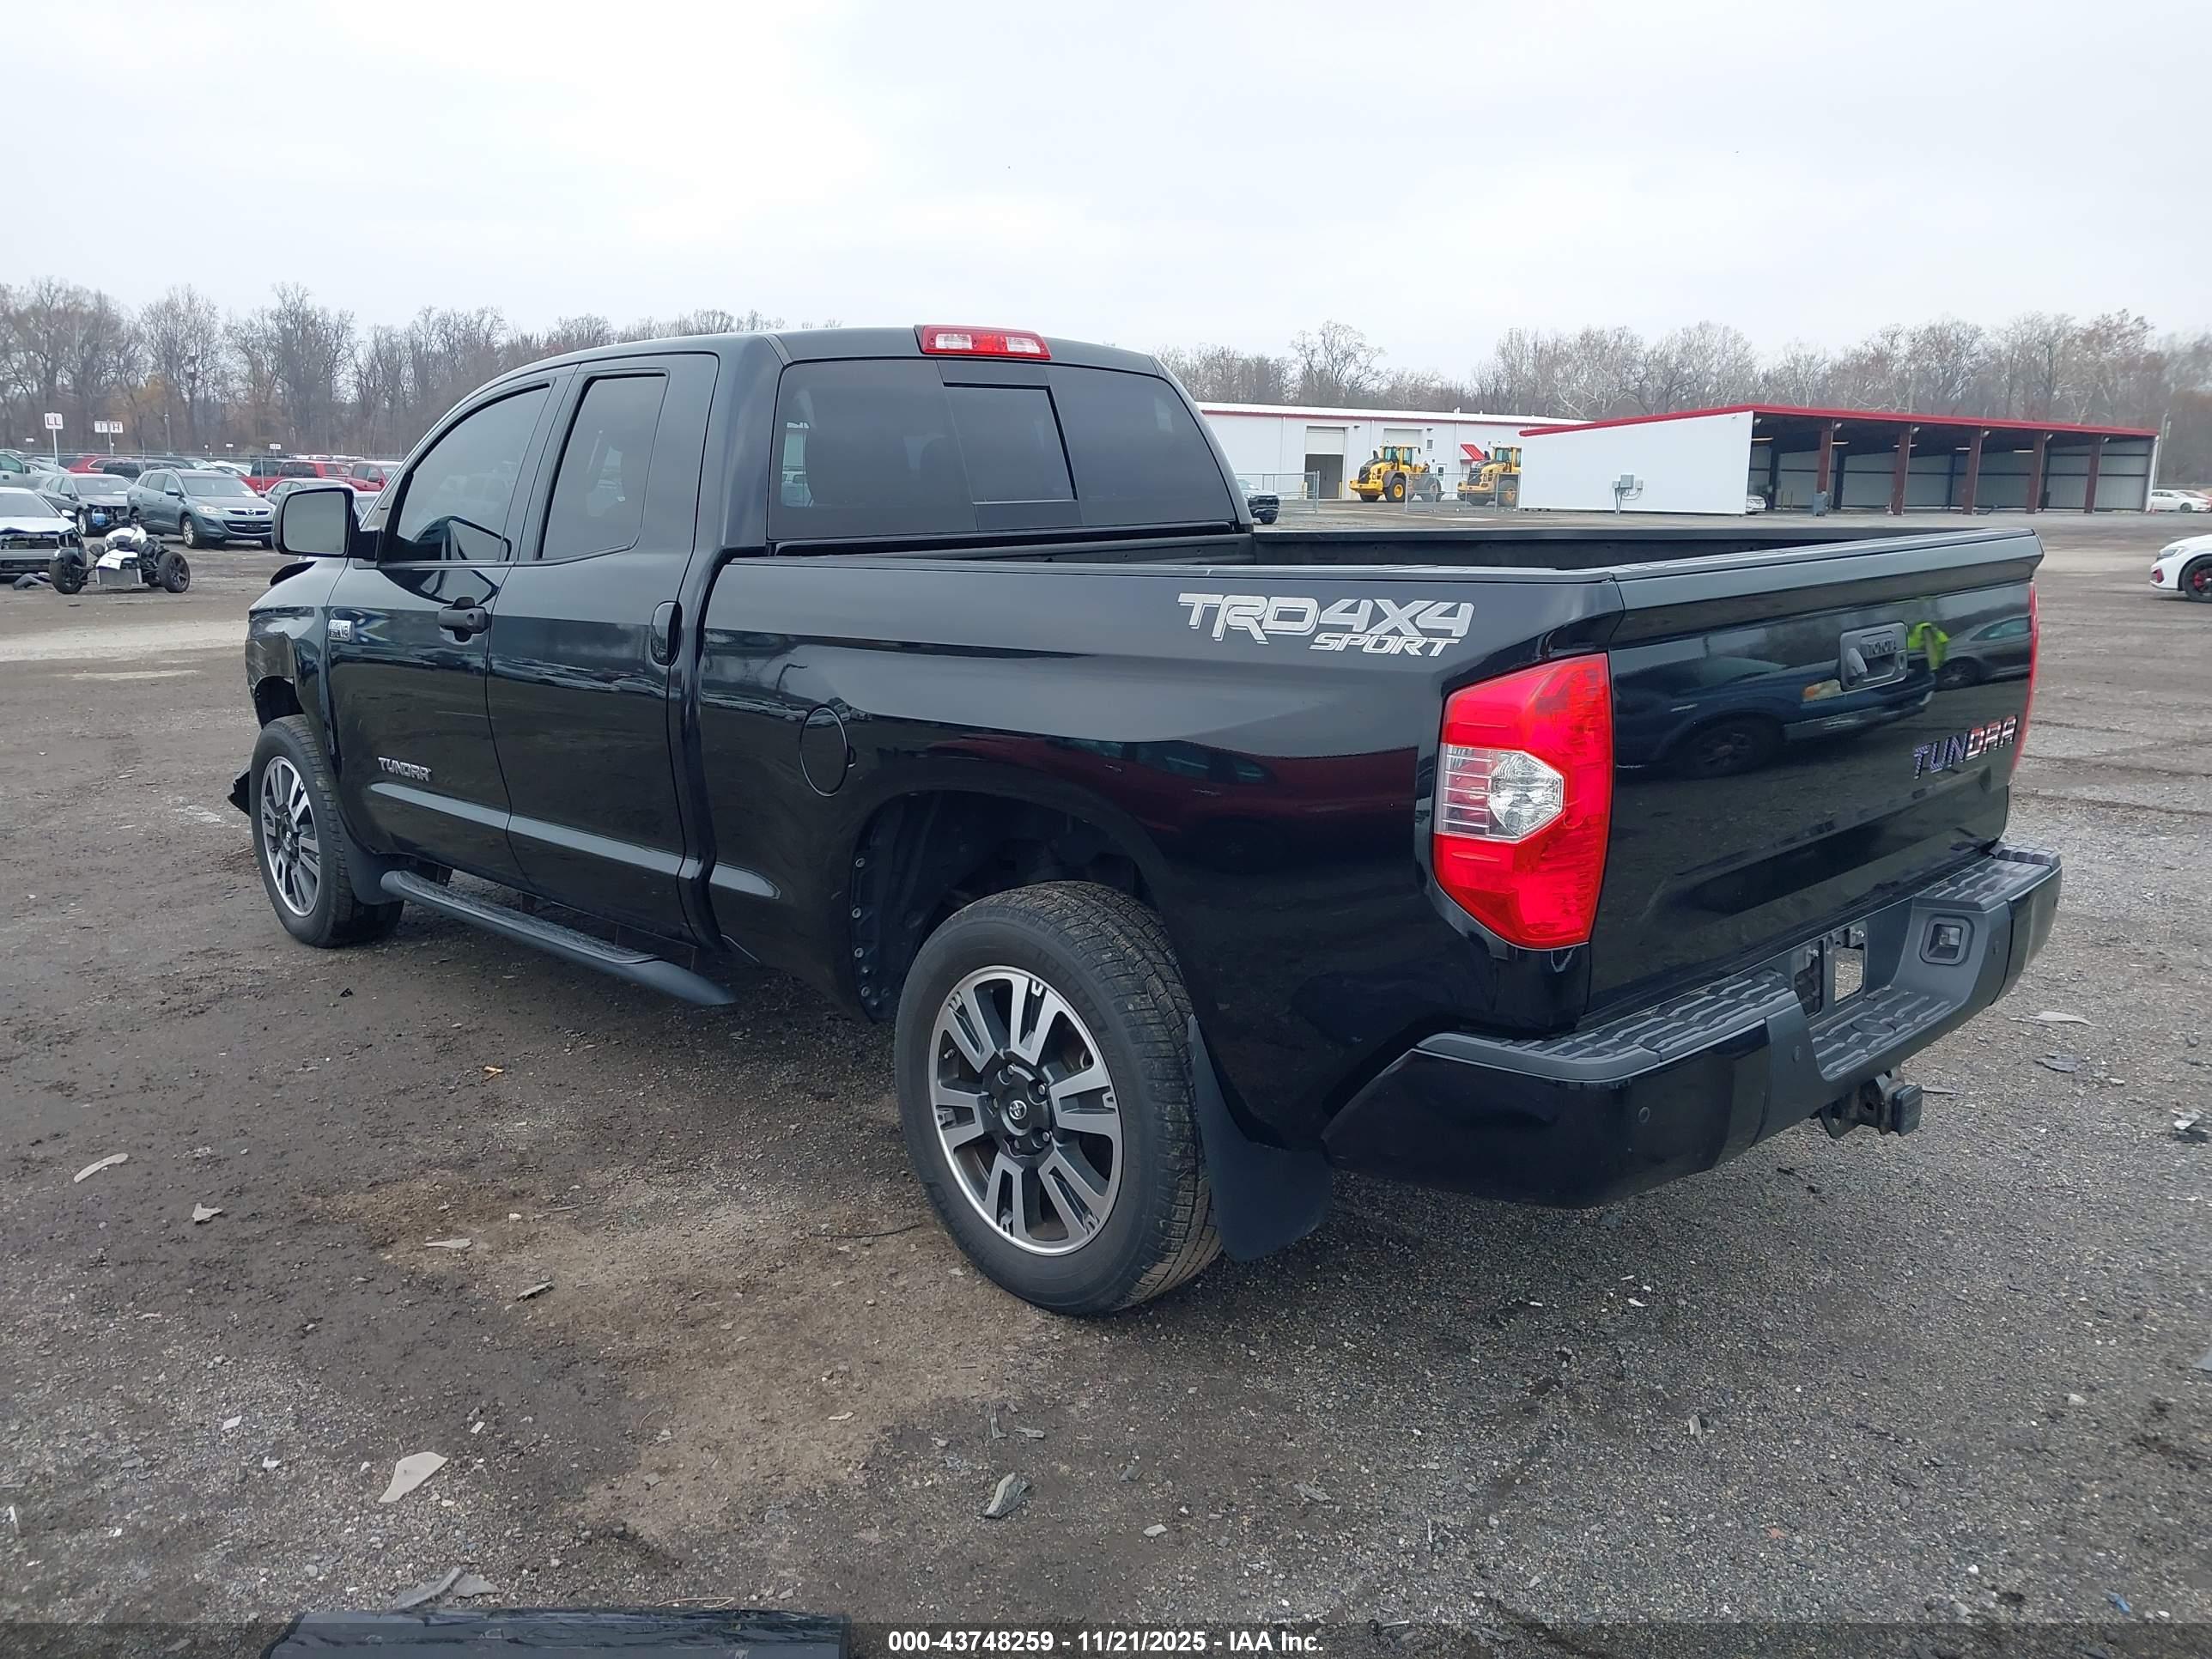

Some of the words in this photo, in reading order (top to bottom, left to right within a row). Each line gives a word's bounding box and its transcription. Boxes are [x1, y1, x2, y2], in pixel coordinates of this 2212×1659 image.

[46, 416, 61, 427] LL
[1309, 631, 1461, 658] SPORT
[1913, 715, 2017, 780] TUNDRA
[378, 757, 431, 782] TUNDRA
